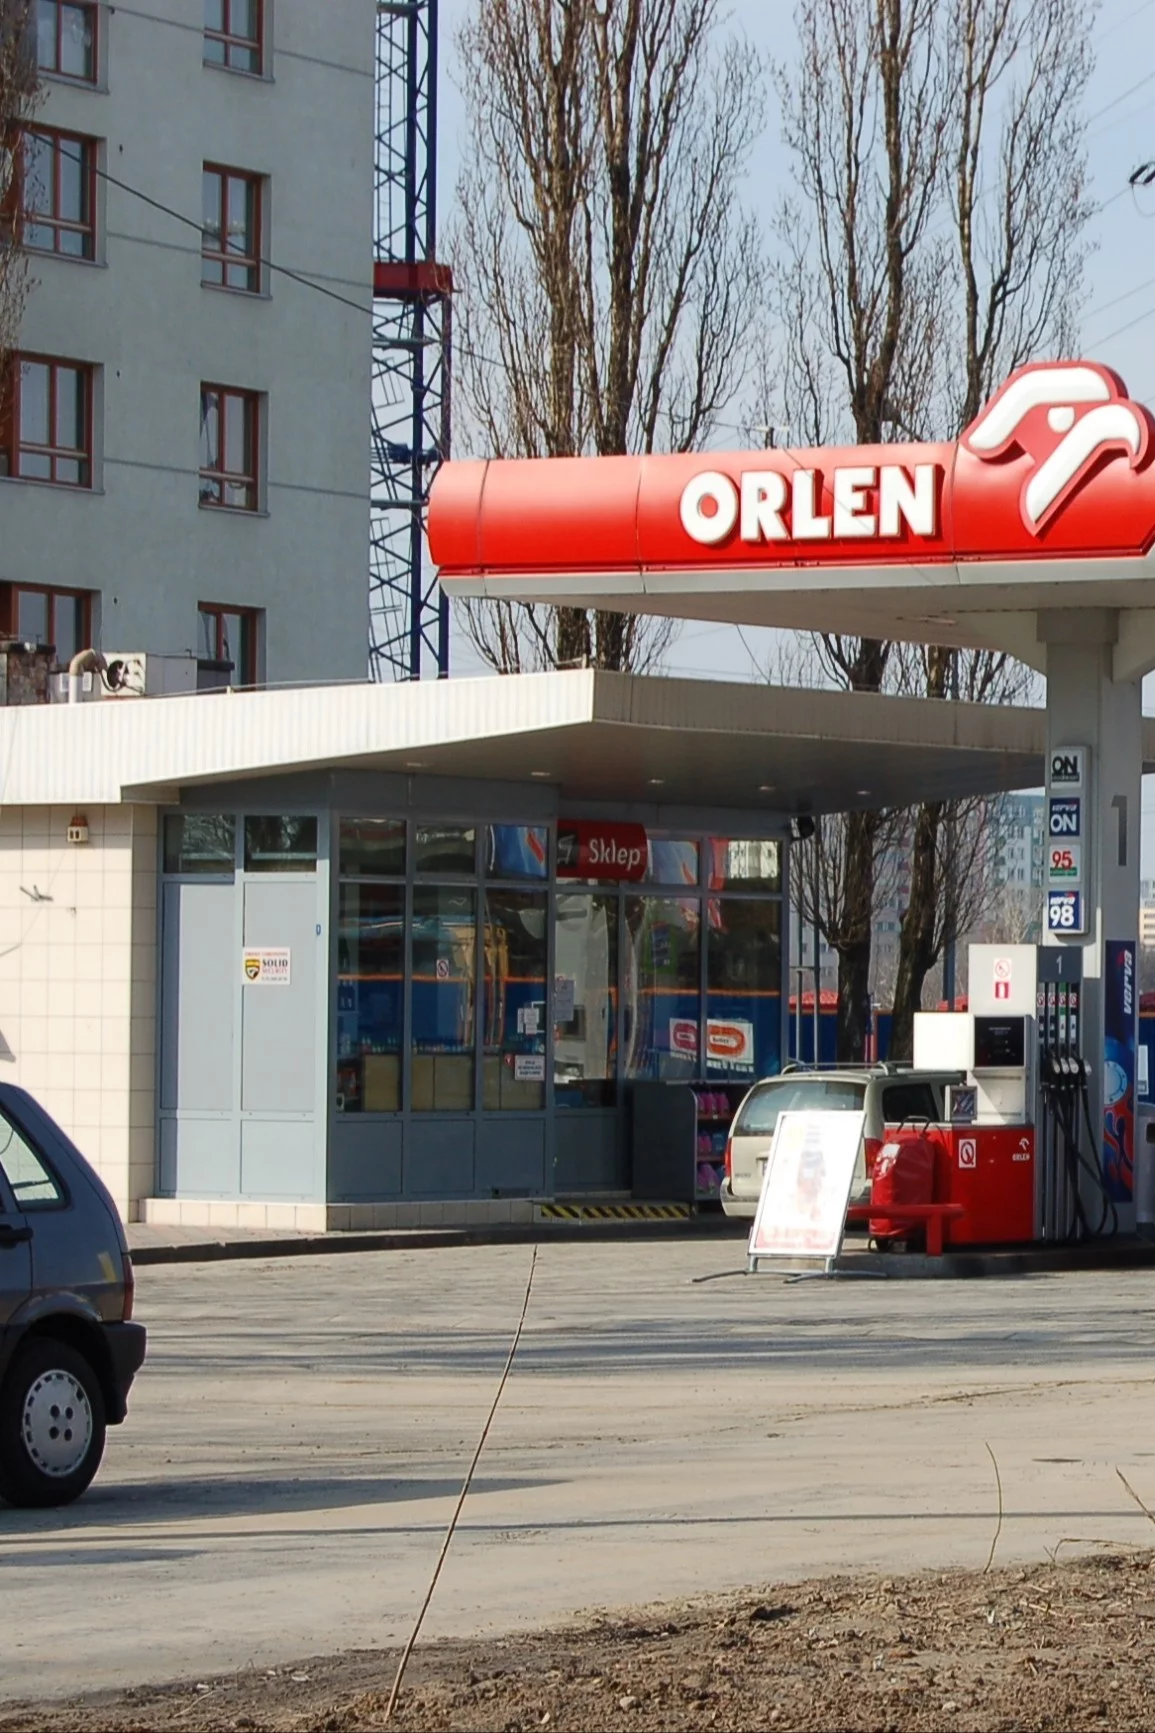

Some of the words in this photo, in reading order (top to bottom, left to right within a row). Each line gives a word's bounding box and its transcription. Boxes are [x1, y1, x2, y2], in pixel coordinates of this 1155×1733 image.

[679, 463, 937, 545] ORLEN
[1052, 756, 1078, 774] ON
[1050, 814, 1077, 832] ON
[1111, 795, 1127, 867] 1
[589, 838, 641, 871] Sklep
[1052, 850, 1073, 870] 95
[1050, 905, 1074, 927] 98
[262, 958, 288, 967] SOLID
[1056, 955, 1062, 974] 1
